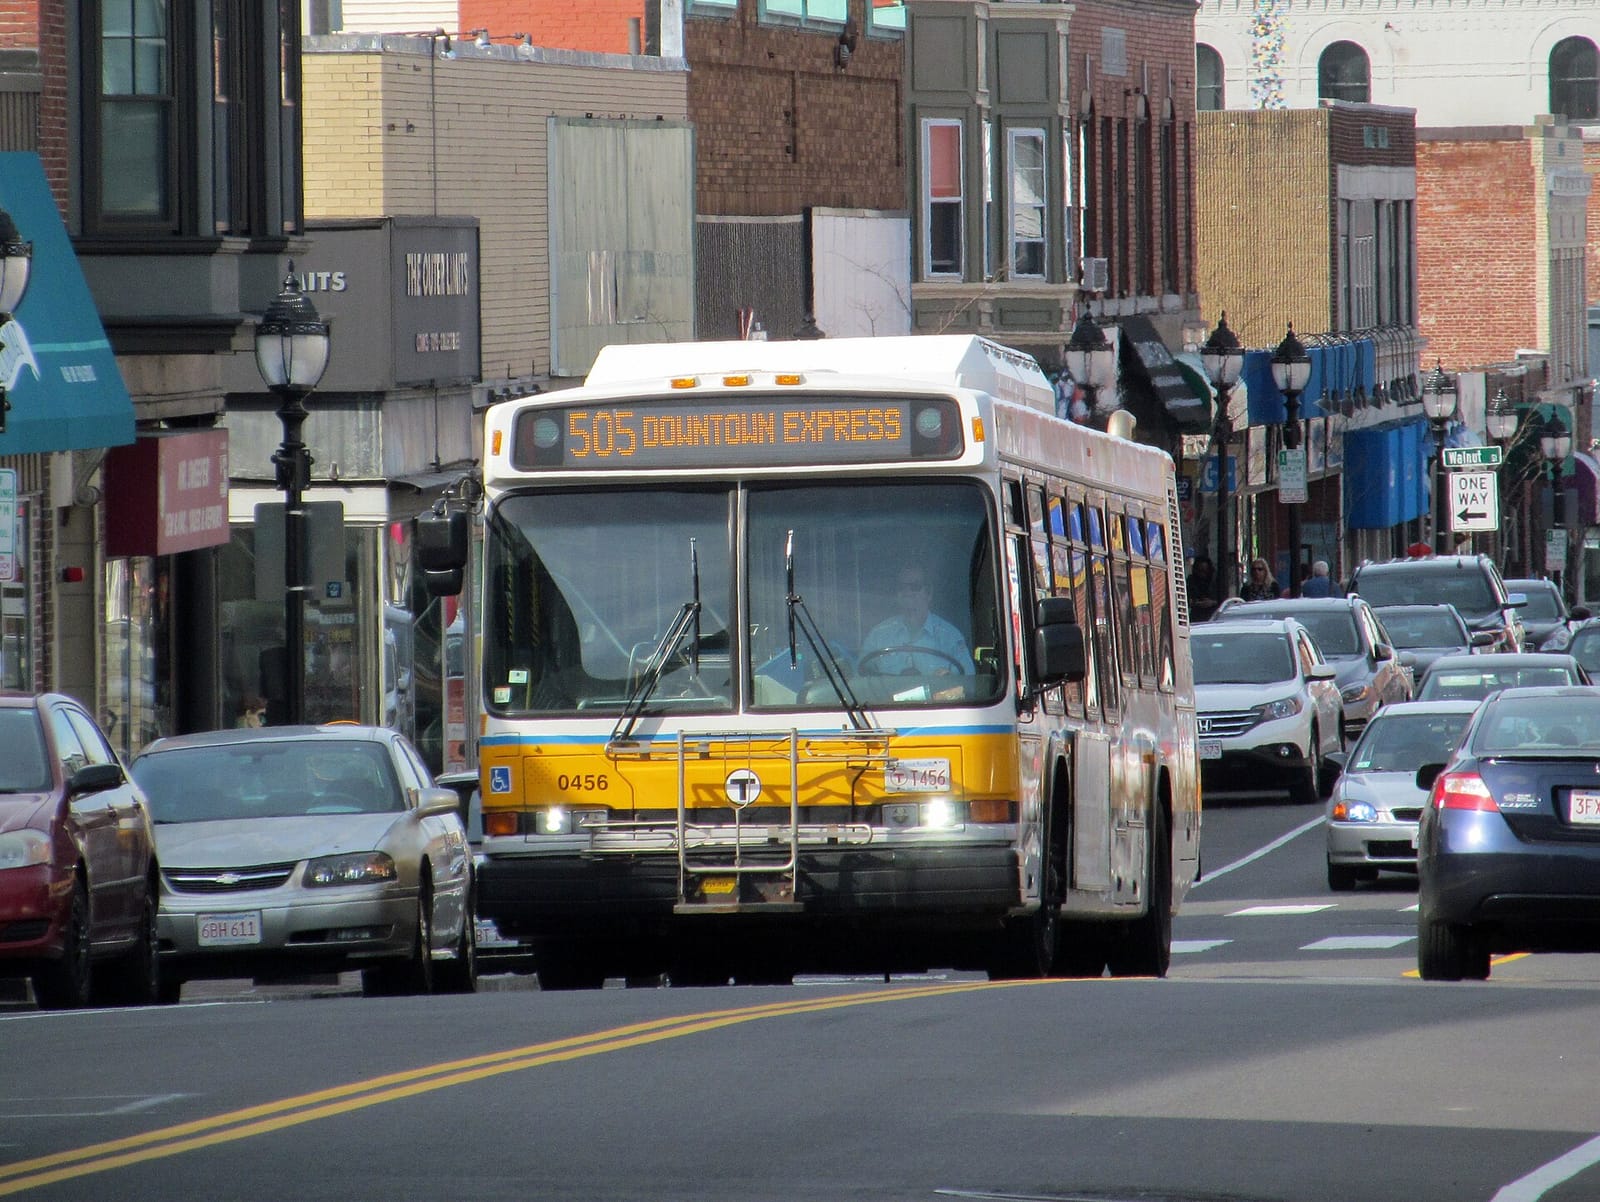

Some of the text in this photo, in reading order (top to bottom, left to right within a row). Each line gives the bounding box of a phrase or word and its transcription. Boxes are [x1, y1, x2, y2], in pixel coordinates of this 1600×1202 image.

[406, 252, 467, 296] THE OUTER LIMITS
[569, 408, 902, 457] 505 DOWNTOWN EXPRESS
[1447, 450, 1482, 464] Walnut
[1459, 477, 1487, 490] ONE
[1458, 493, 1488, 505] WAY
[558, 774, 609, 791] 0456
[911, 769, 946, 787] T456
[730, 778, 756, 801] T
[202, 920, 257, 938] 6BH 611
